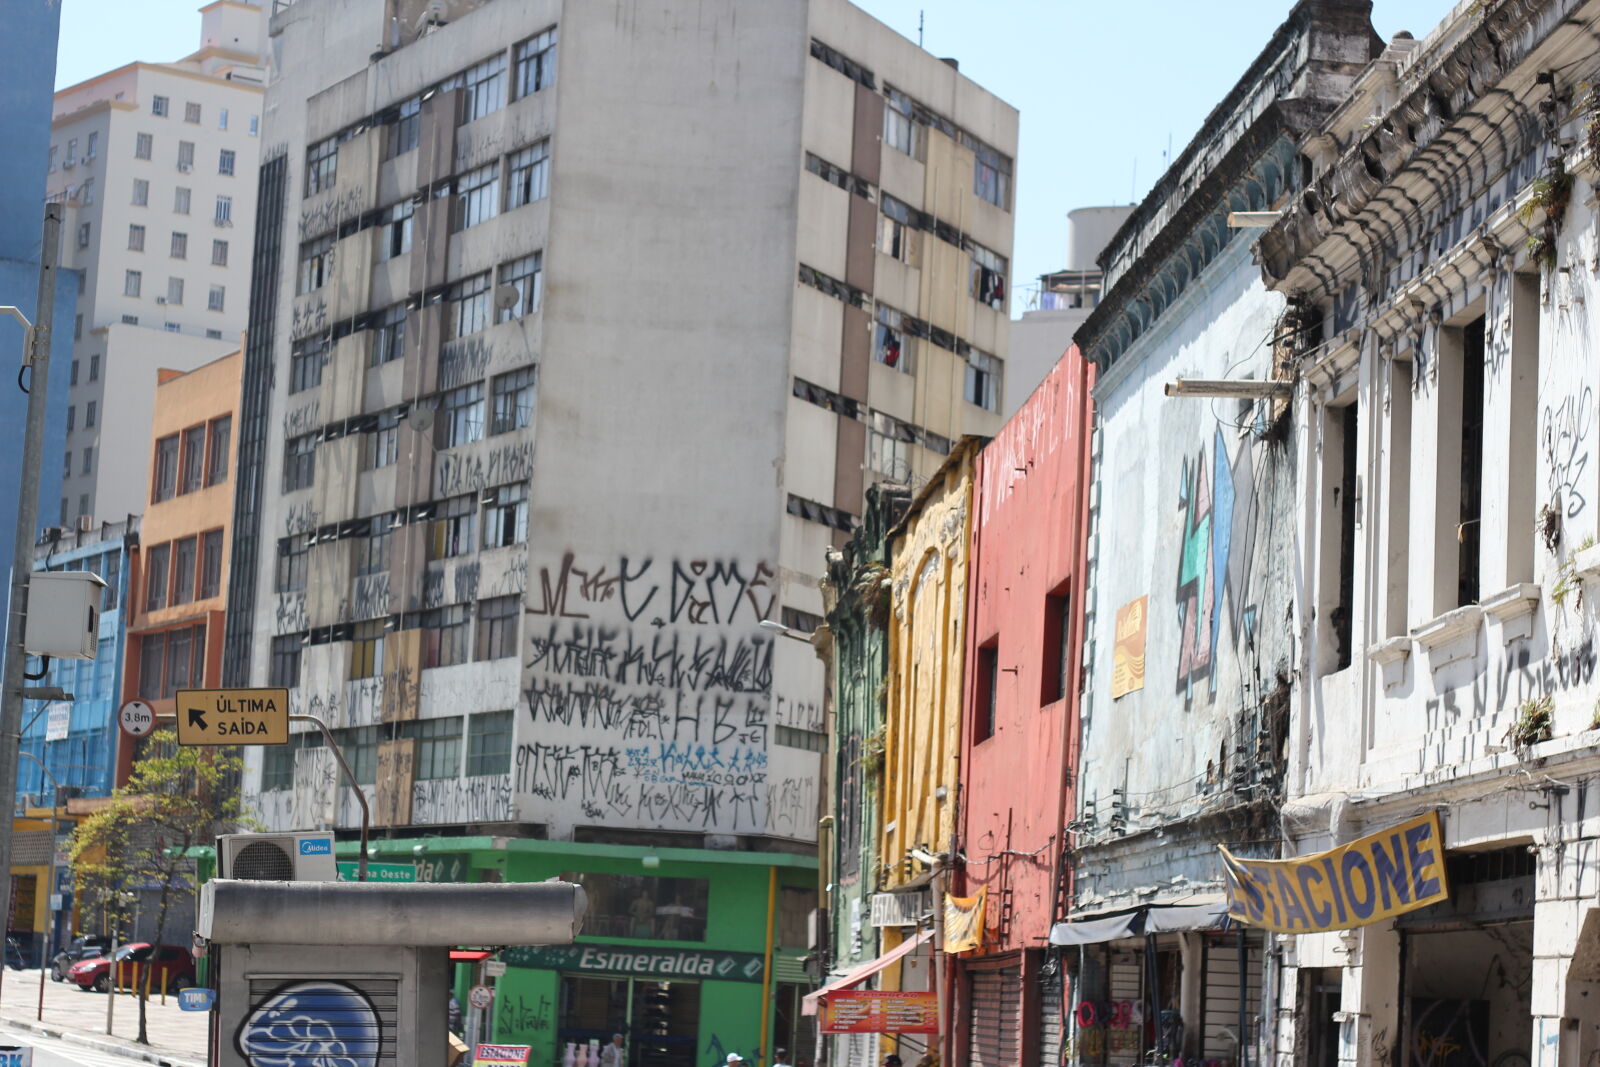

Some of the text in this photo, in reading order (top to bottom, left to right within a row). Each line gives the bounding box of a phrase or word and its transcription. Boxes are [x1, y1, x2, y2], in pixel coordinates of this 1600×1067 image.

[217, 695, 277, 712] ÚLTIMA
[218, 717, 268, 735] SAÍDA
[352, 868, 411, 880] Zna Oeste
[579, 948, 715, 975] Esmeralda
